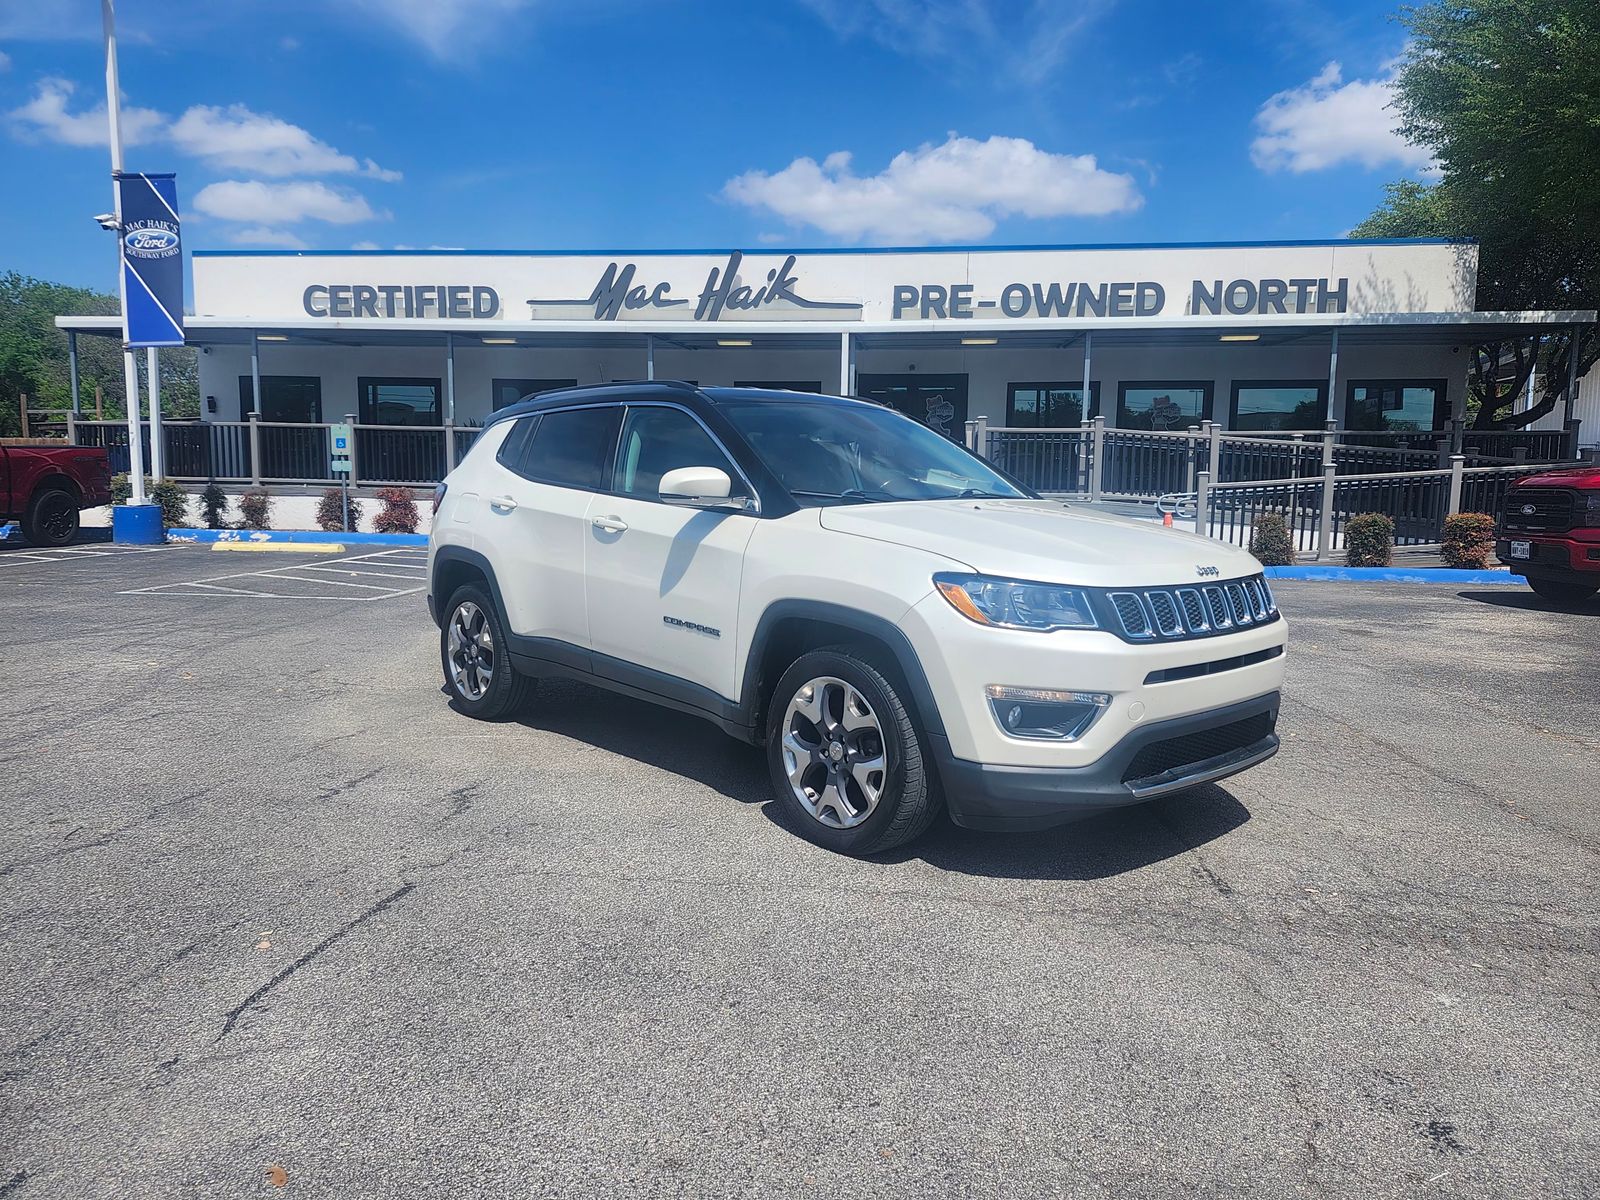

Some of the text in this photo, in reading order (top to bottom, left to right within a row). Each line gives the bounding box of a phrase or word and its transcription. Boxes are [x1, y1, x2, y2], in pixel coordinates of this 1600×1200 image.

[124, 219, 179, 233] MAC HAIK'S
[134, 232, 168, 248] Ford
[125, 247, 180, 259] SOUTHWAY FORD
[694, 250, 864, 321] Haik
[303, 284, 500, 319] CERTIFIED
[893, 277, 1349, 319] PRE-OWNED NORTH
[1196, 564, 1219, 578] Jeep
[663, 615, 720, 637] COMPASS
